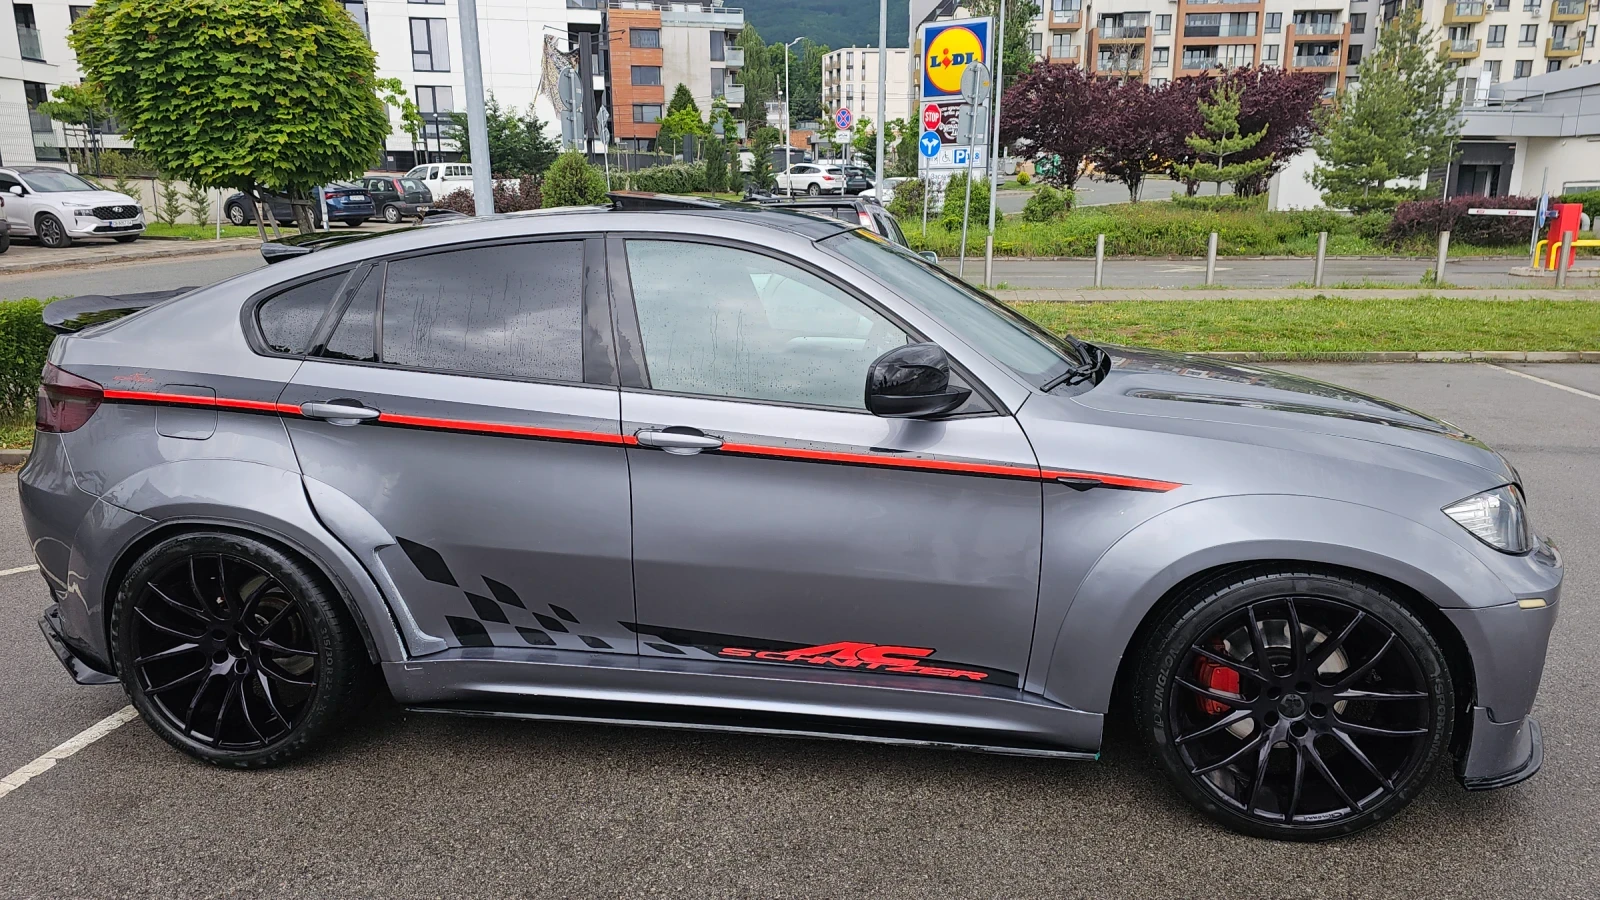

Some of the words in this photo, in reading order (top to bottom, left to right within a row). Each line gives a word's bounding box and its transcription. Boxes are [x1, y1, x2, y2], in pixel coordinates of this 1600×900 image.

[924, 112, 939, 123] STOP
[782, 641, 937, 666] AC
[718, 647, 989, 681] SCHNITZER
[325, 677, 333, 691] 22
